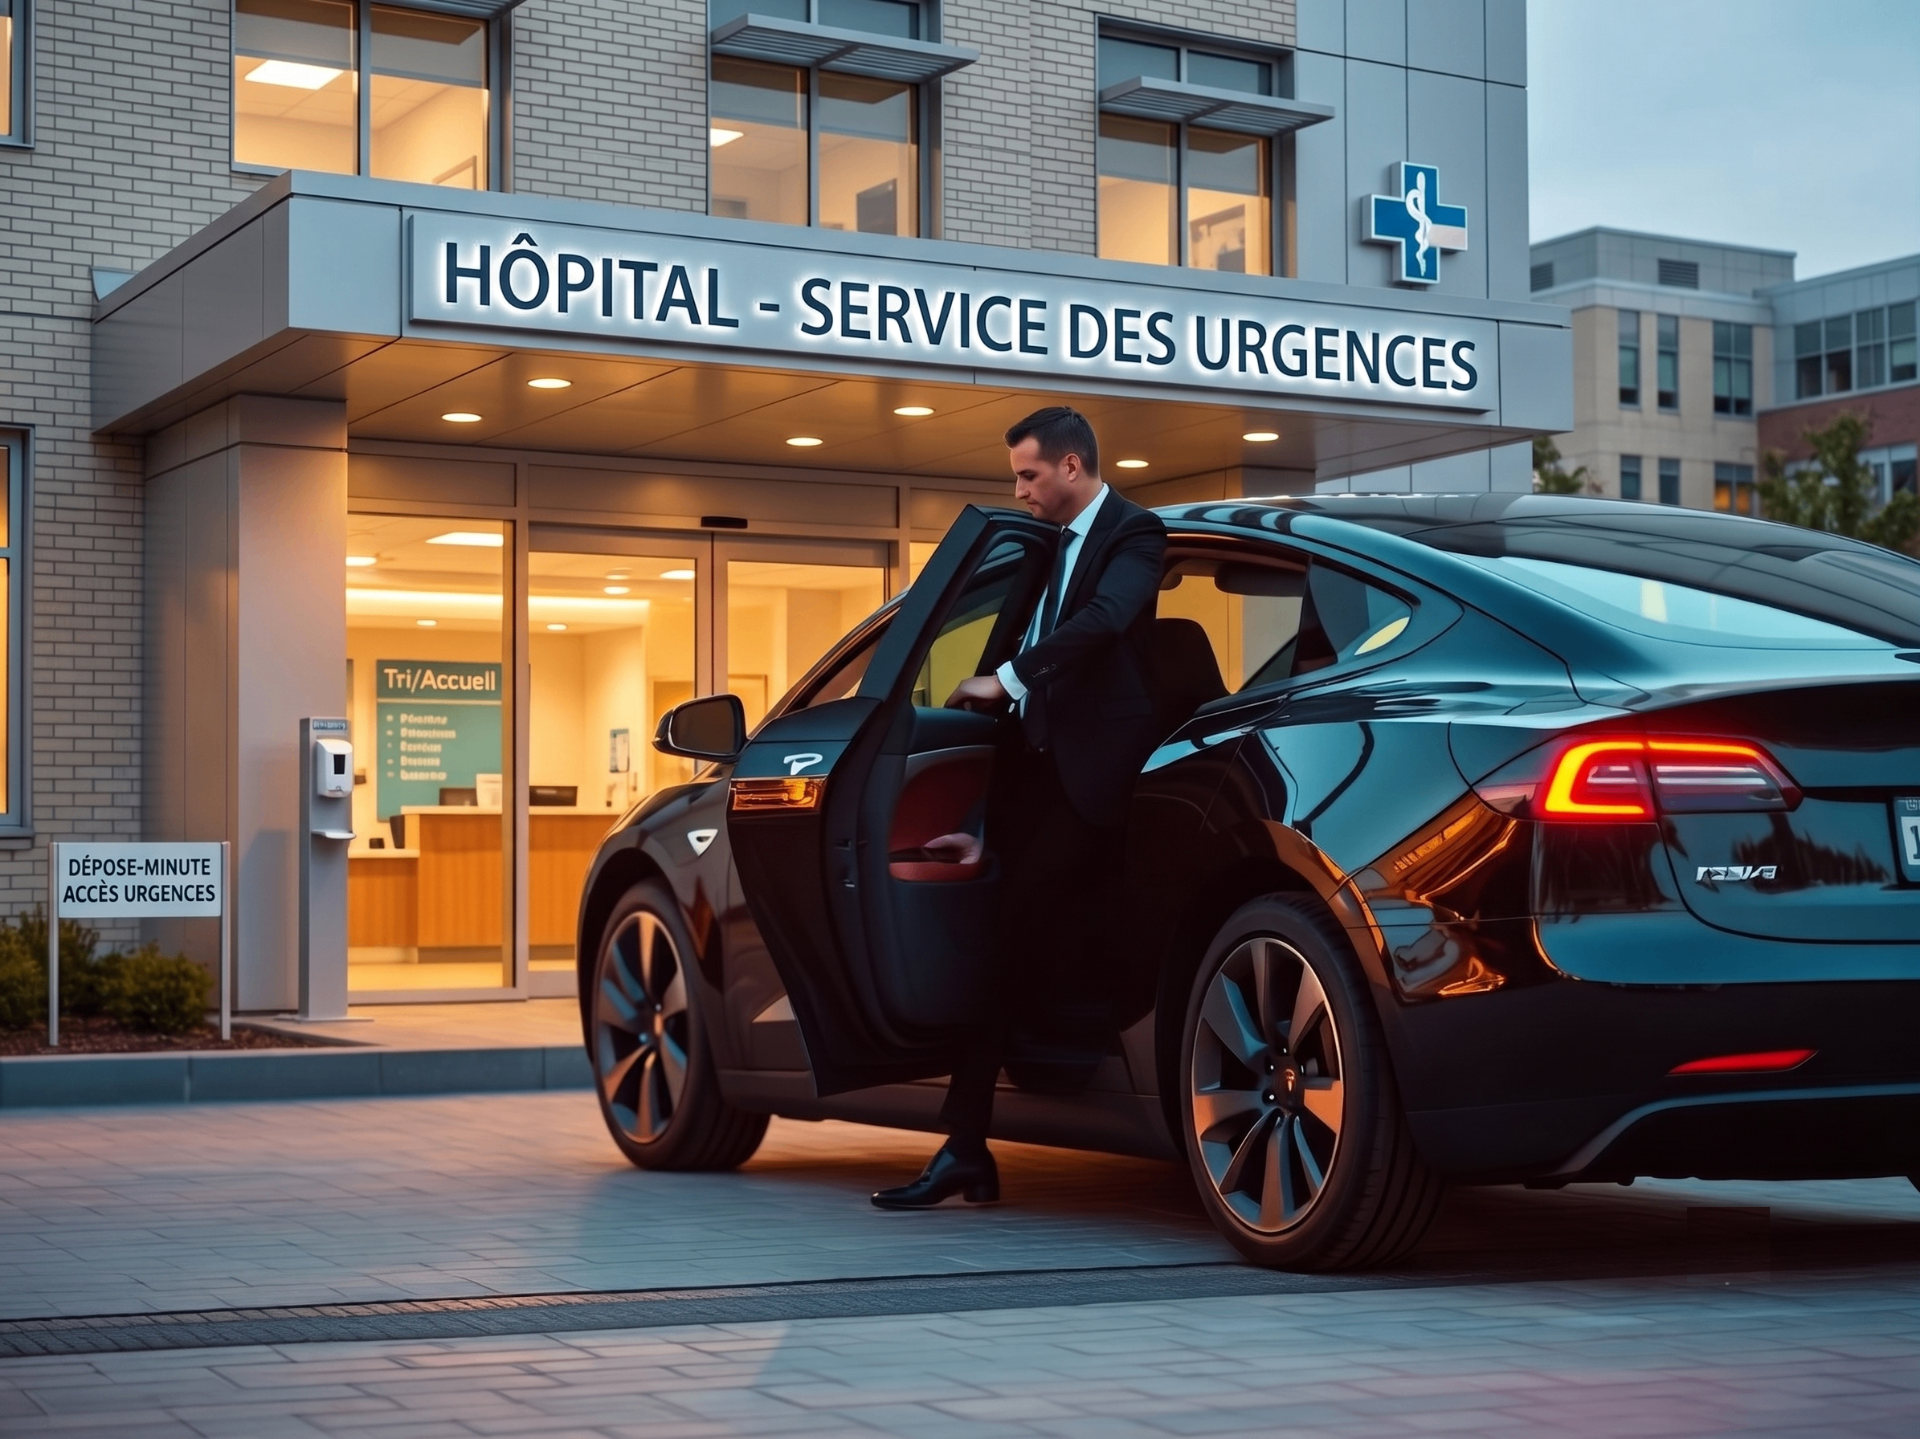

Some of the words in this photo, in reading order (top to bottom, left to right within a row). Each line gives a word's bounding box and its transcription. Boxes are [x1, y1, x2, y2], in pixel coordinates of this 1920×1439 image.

[445, 233, 739, 328] HÔPITAL
[800, 278, 1048, 355] SERVICE
[1069, 303, 1176, 366] DES
[1196, 315, 1478, 391] URGENCES
[69, 854, 211, 876] DÉPOSE-MINUTE
[63, 879, 119, 903] ACCÈS
[124, 884, 215, 902] URGENCES
